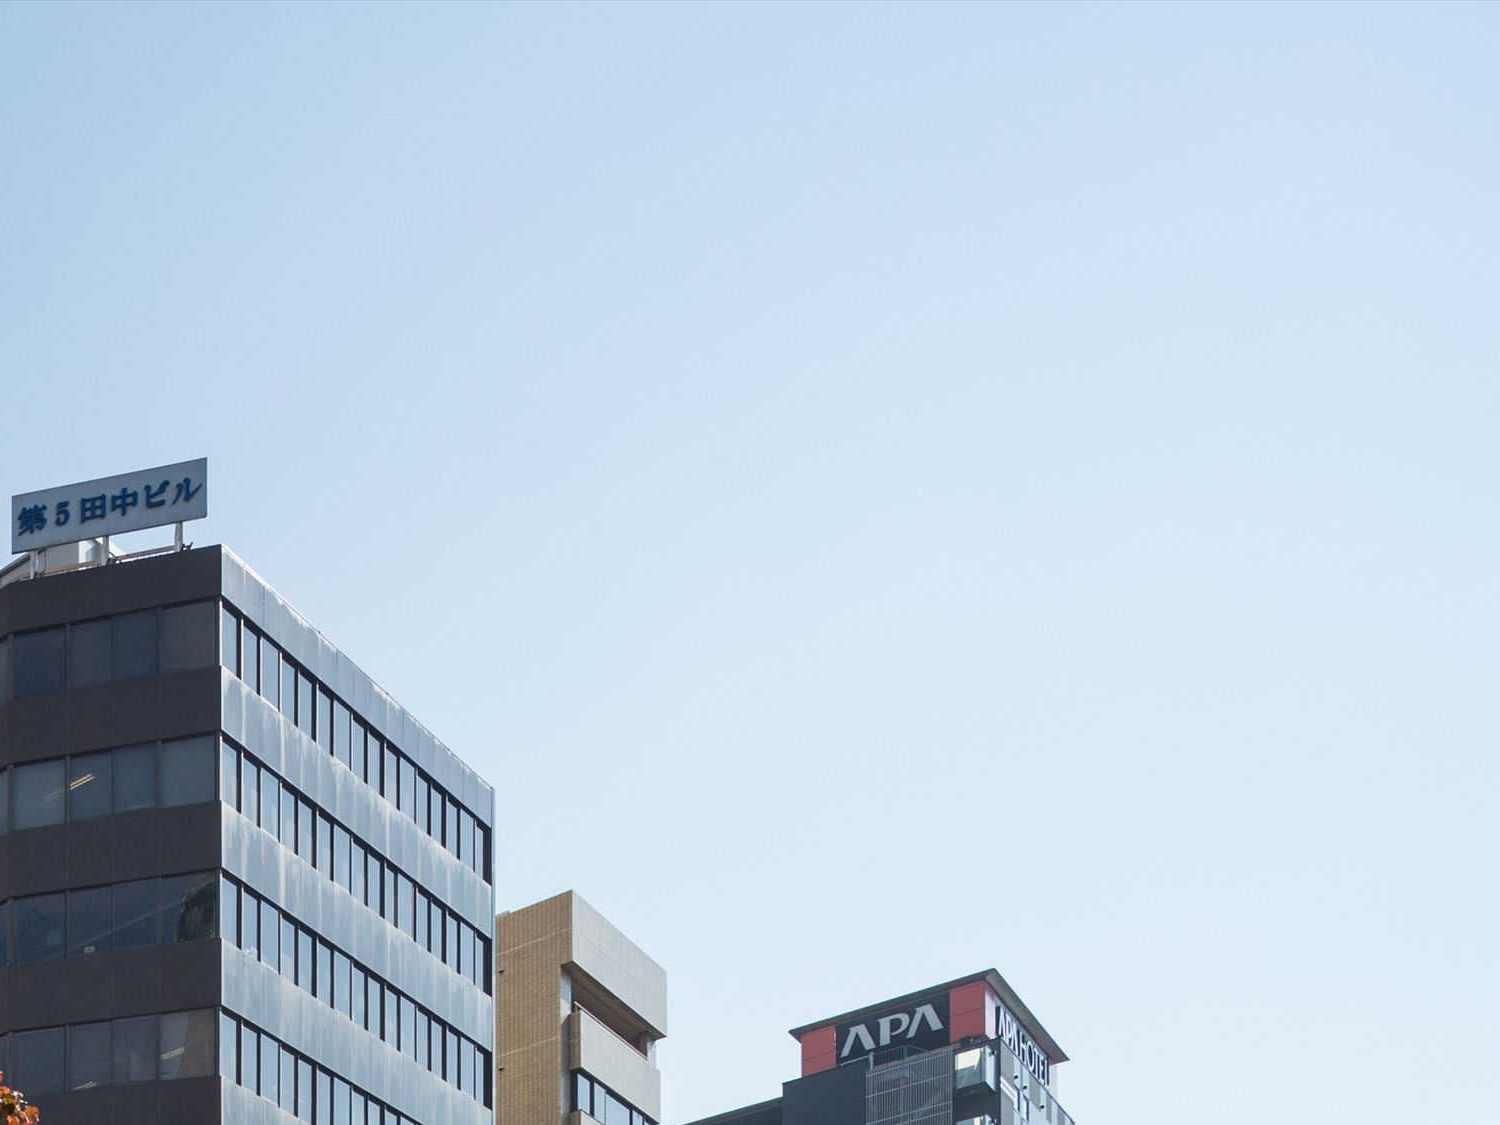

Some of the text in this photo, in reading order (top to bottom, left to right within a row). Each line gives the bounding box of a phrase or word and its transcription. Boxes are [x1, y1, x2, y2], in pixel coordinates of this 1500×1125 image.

[17, 477, 203, 536] 第5田中ビル
[840, 1003, 944, 1058] APA
[998, 1006, 1049, 1088] APA HOTEL
